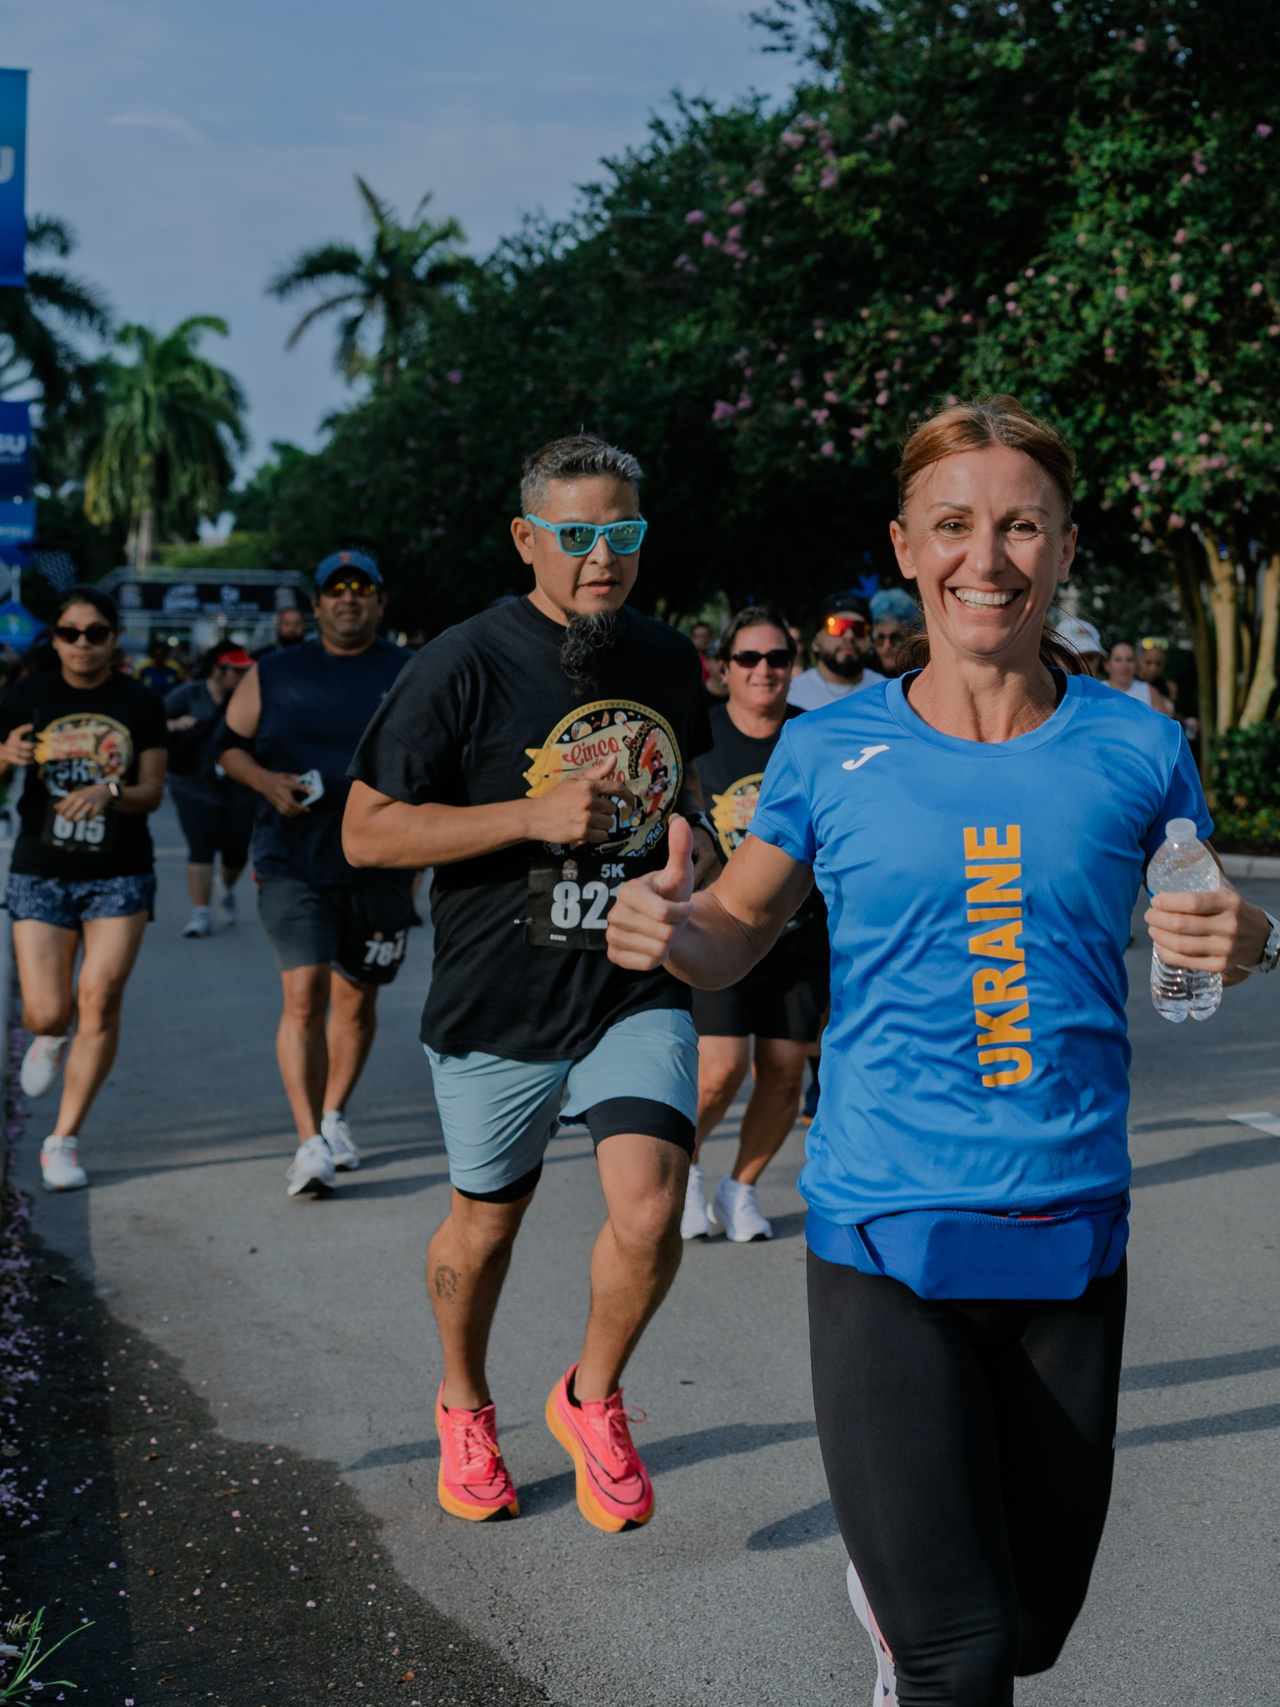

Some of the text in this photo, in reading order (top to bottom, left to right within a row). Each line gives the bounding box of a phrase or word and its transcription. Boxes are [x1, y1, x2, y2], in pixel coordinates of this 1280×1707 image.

[562, 736, 622, 766] Cinco
[600, 863, 625, 878] 5K
[963, 825, 1033, 1087] UKRAINE
